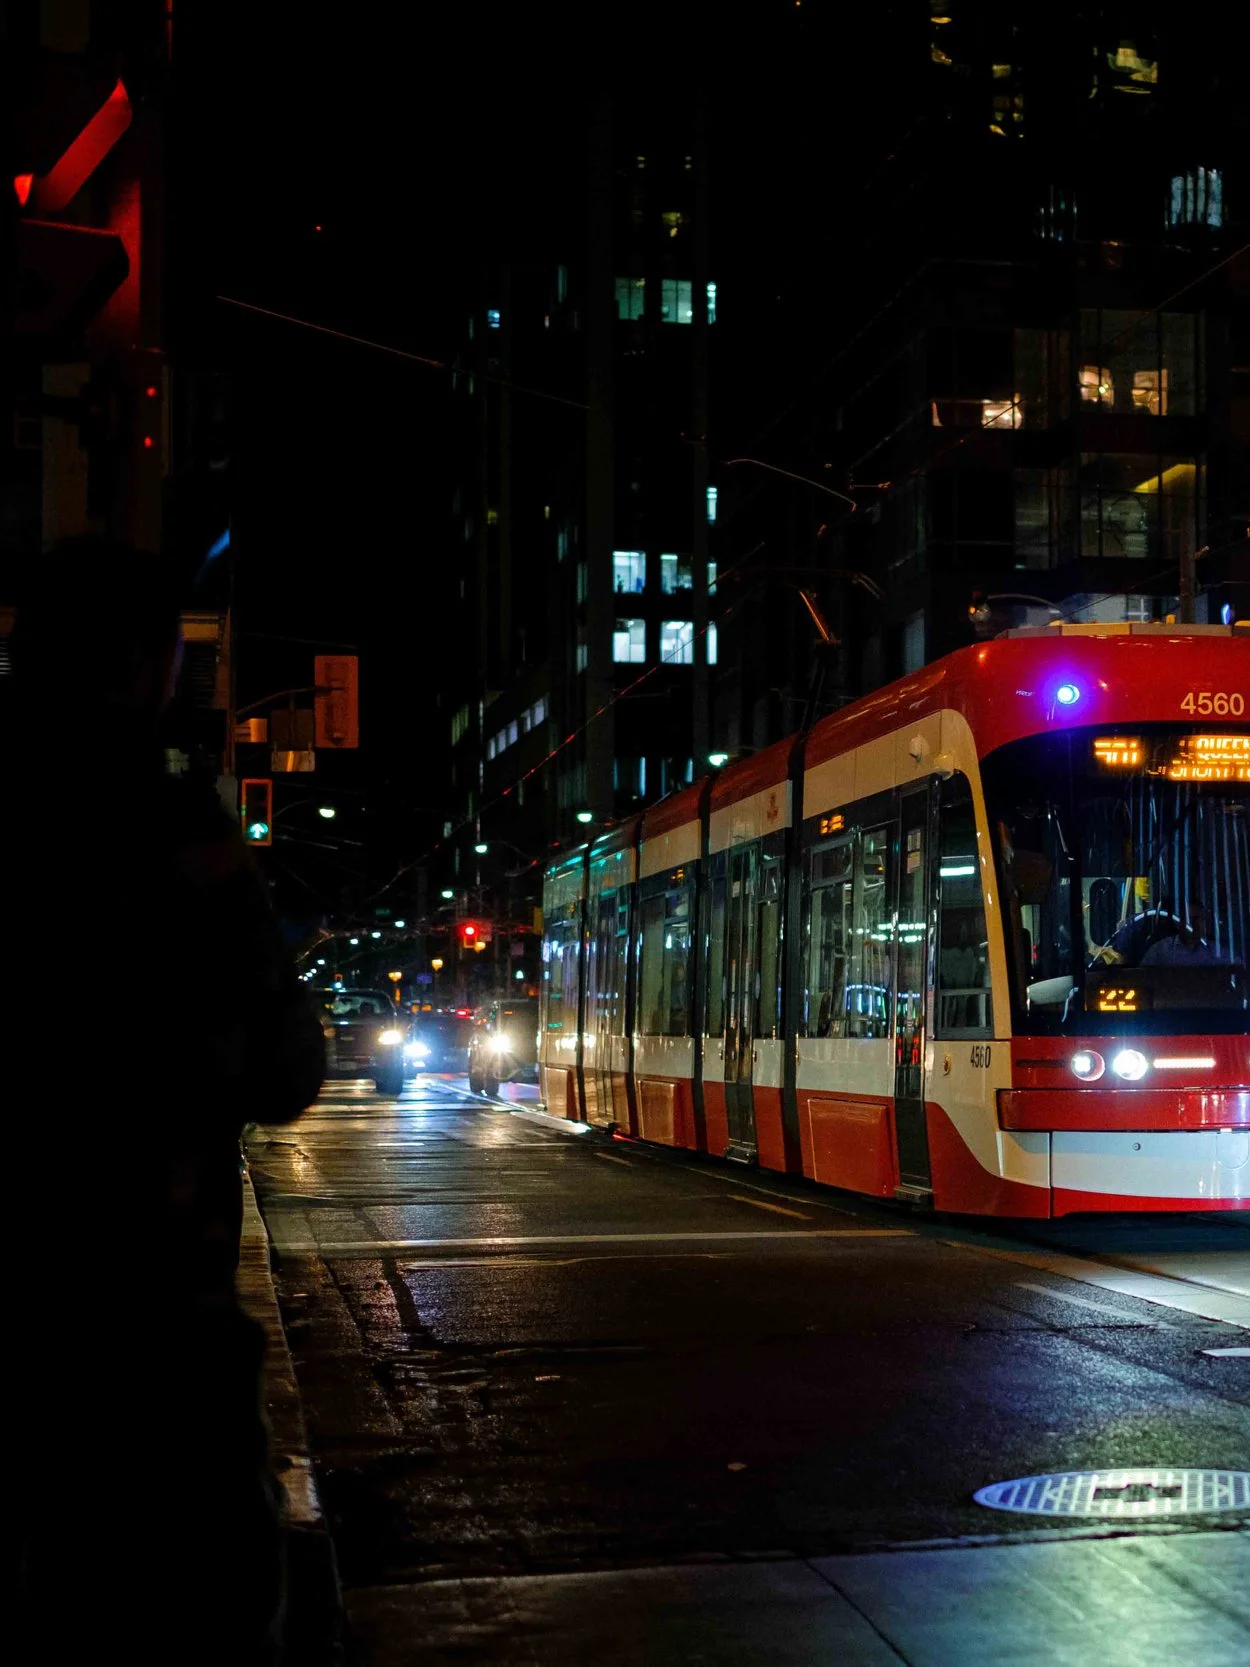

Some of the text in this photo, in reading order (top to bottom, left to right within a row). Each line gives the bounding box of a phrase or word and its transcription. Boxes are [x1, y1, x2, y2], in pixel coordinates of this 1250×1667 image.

[1180, 692, 1245, 716] 4560
[1099, 990, 1136, 1011] 22
[970, 1045, 991, 1069] 4560
